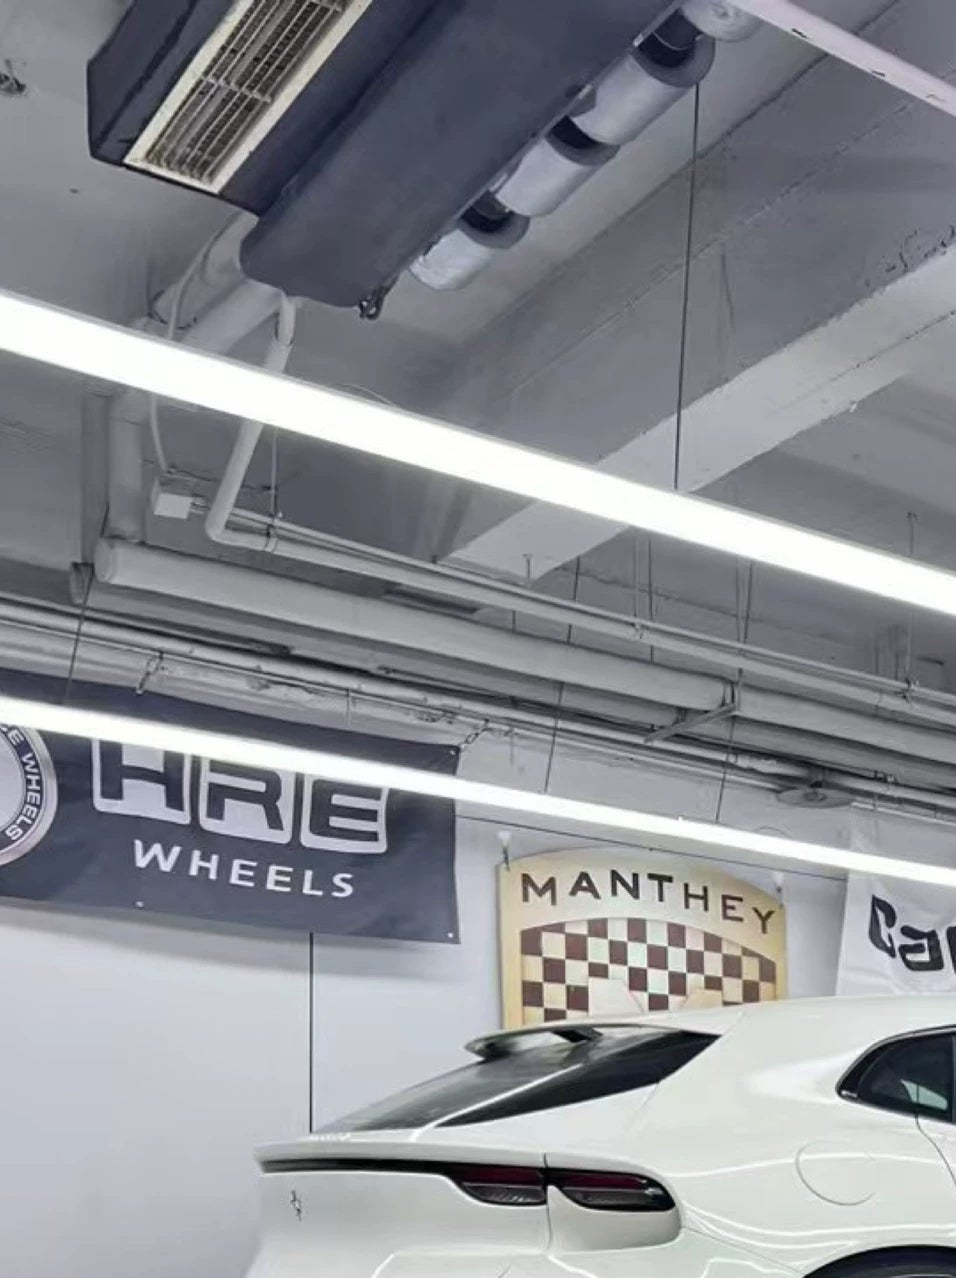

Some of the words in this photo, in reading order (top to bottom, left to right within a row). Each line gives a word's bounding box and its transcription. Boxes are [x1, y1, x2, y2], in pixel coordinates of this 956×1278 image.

[5, 752, 41, 841] WHEELS
[94, 738, 390, 852] HRE
[133, 839, 355, 898] WHEELS
[520, 869, 776, 935] MANTHEY
